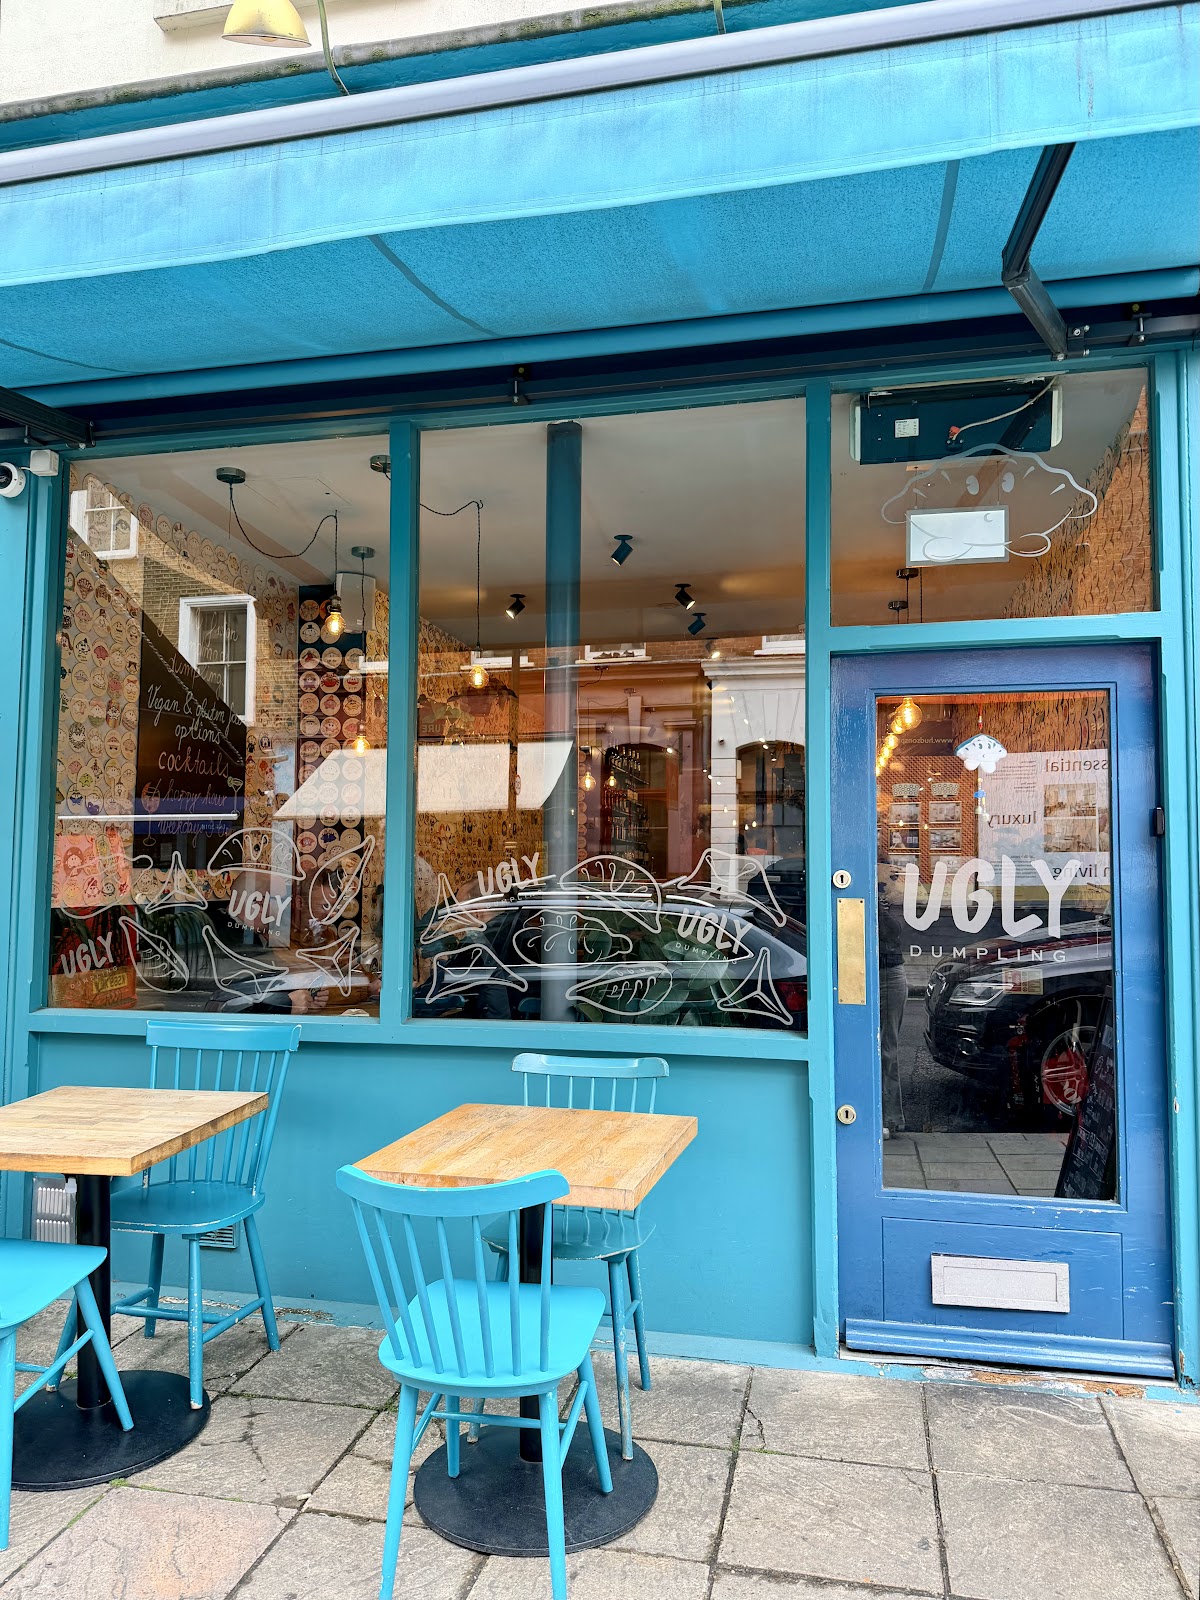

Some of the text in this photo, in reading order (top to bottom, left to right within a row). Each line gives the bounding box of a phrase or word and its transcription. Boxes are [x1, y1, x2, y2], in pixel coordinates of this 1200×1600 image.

[147, 684, 180, 727] Vegan
[183, 690, 193, 715] &
[175, 718, 221, 751] options
[158, 746, 229, 778] cocktails
[162, 779, 227, 814] happy hour
[477, 852, 540, 896] UGLY
[228, 889, 292, 927] UGLY
[903, 854, 1082, 939] UGLY
[227, 921, 281, 937] DUMPLING
[677, 907, 754, 955] UGLY
[60, 931, 114, 978] UGLY
[675, 941, 737, 965] DUMPLING
[909, 945, 1066, 962] DUMPLING
